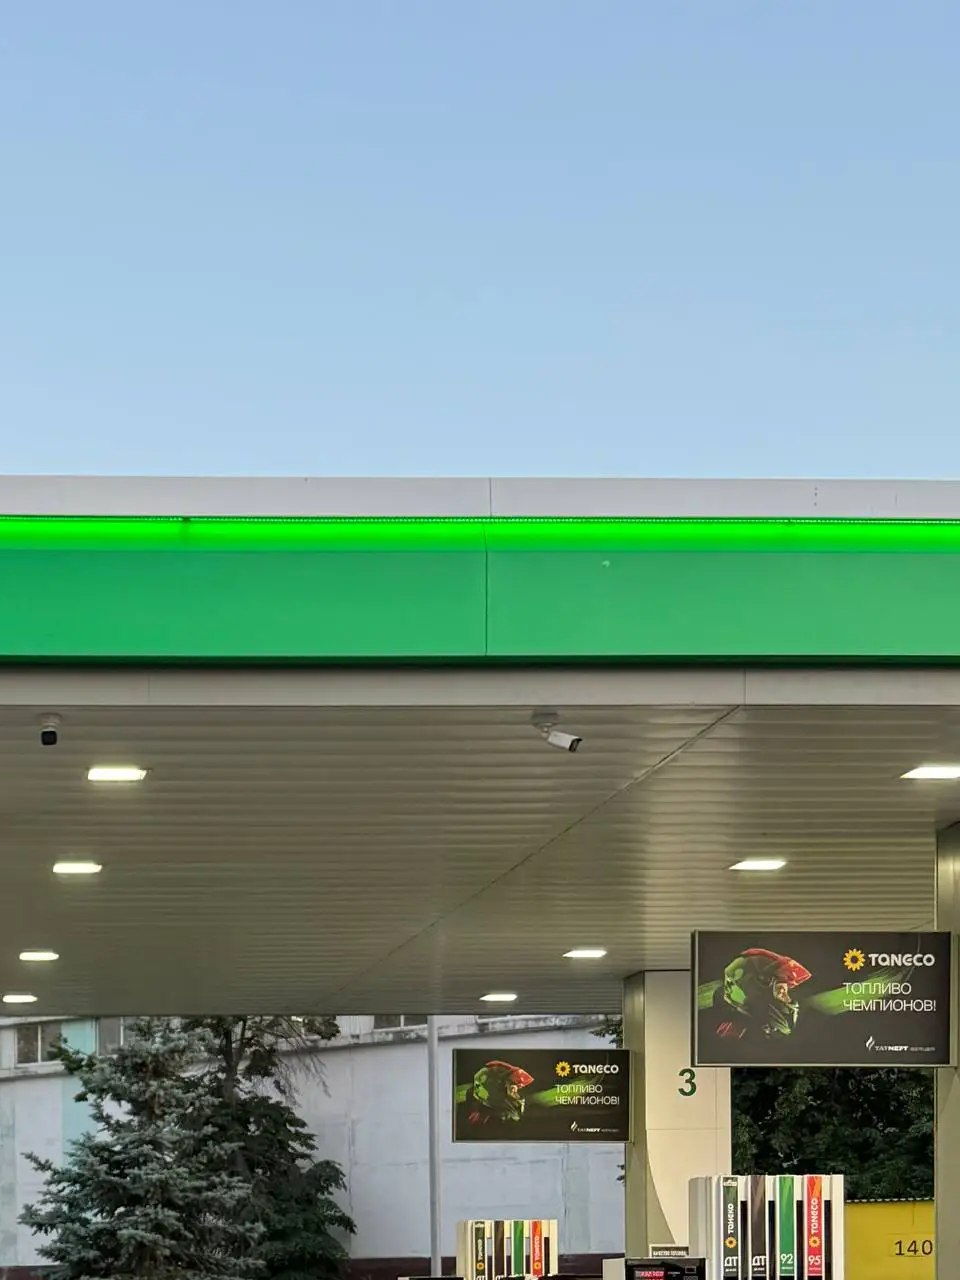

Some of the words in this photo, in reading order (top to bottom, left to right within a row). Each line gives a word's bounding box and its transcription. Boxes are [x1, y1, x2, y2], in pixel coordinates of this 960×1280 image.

[843, 982, 911, 995] ТОПЛИВО
[843, 999, 936, 1012] ЧЕМПИОНОВ!
[678, 1068, 697, 1096] 3
[555, 1084, 602, 1093] ТОПЛИВО
[555, 1096, 620, 1105] ЧЕМПИОНОВ!
[895, 1240, 933, 1256] 140
[724, 1256, 738, 1267] ДТ
[752, 1256, 766, 1266] ДТ
[780, 1254, 793, 1264] 92
[808, 1255, 821, 1265] 95
